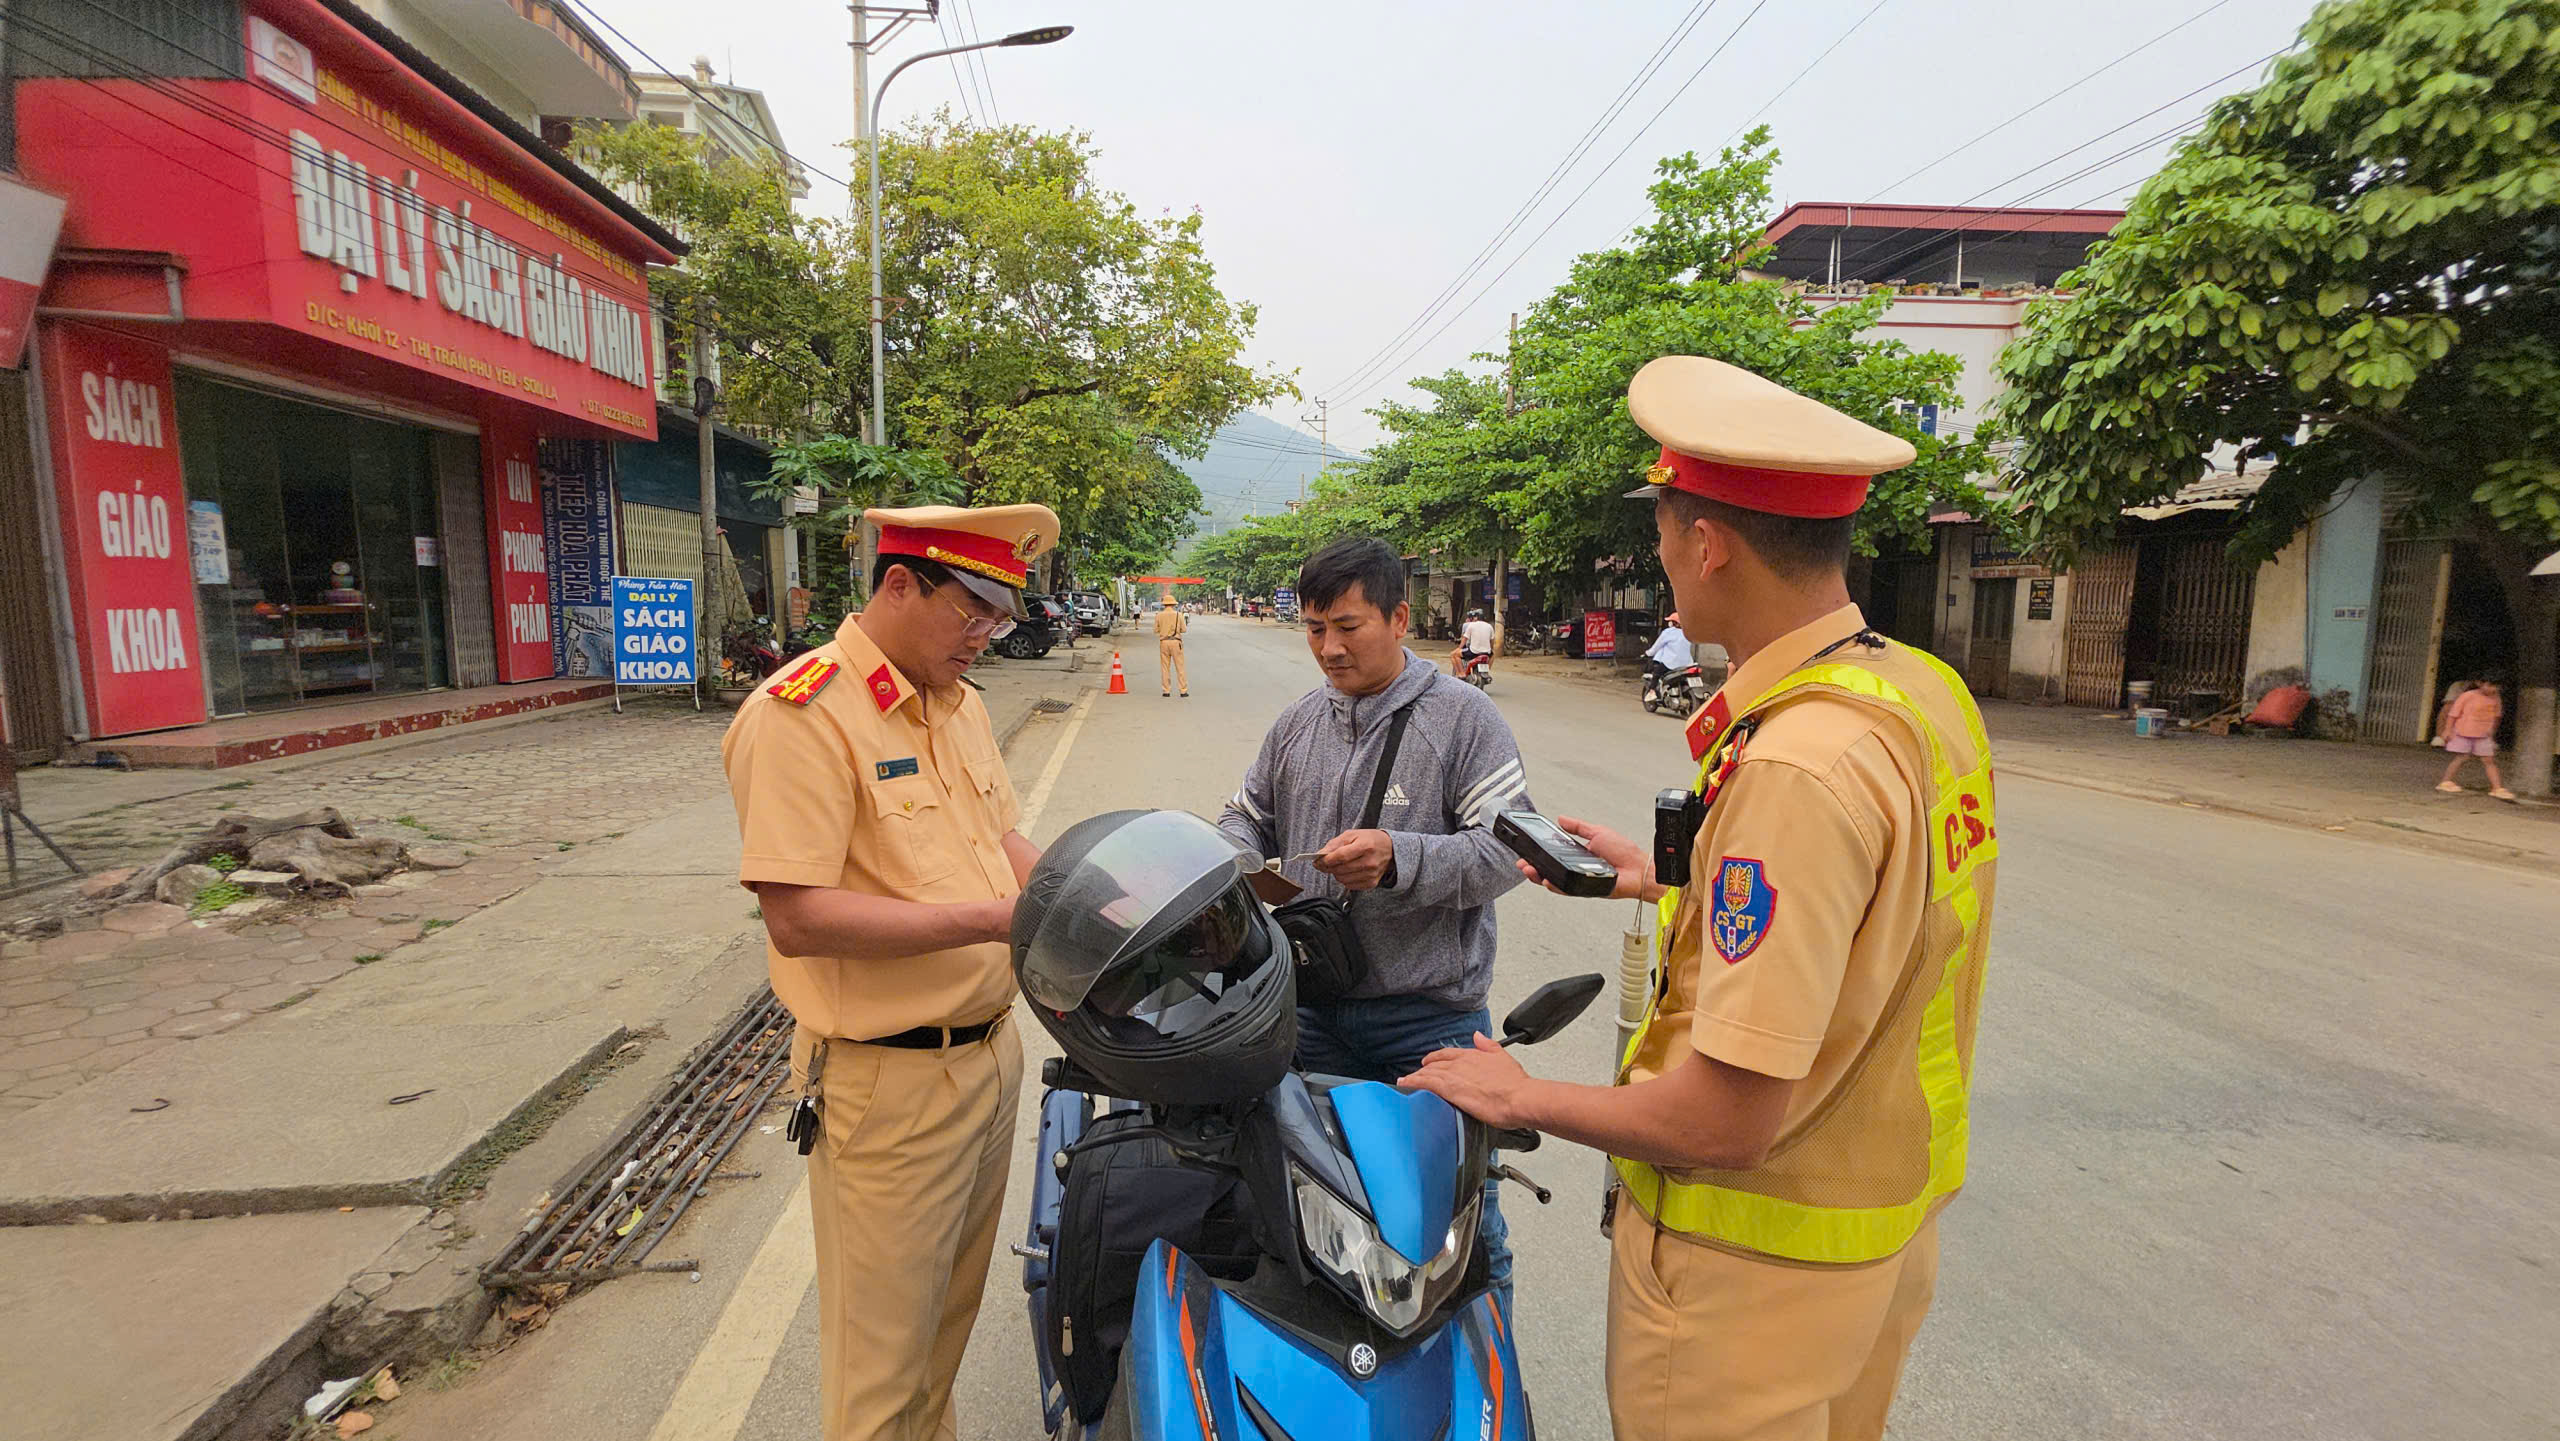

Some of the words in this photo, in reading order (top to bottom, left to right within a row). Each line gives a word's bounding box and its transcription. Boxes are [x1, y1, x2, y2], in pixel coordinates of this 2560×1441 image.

[289, 129, 378, 293] ĐẠI
[374, 168, 428, 300] LÝ
[432, 200, 525, 338] SÁCH
[523, 252, 587, 363] GIÁO
[585, 286, 648, 389] KHOA
[82, 361, 163, 449] SÁCH
[505, 451, 533, 504] VĂN
[556, 474, 592, 518] THÉP
[98, 479, 171, 560] GIÁO
[595, 490, 607, 517] CÔNG
[503, 522, 546, 573] PHÒNG
[560, 520, 595, 557] HÒA
[598, 531, 609, 557] TNHH
[562, 559, 597, 604] PHÁT
[510, 584, 549, 644] PHẨM
[623, 606, 686, 628] SÁCH
[106, 608, 188, 674] KHOA
[623, 632, 687, 654] GIÁO
[620, 661, 692, 680] KHOA
[1383, 797, 1410, 806] didas
[1715, 910, 1730, 927] CS
[1735, 913, 1756, 931] GT
